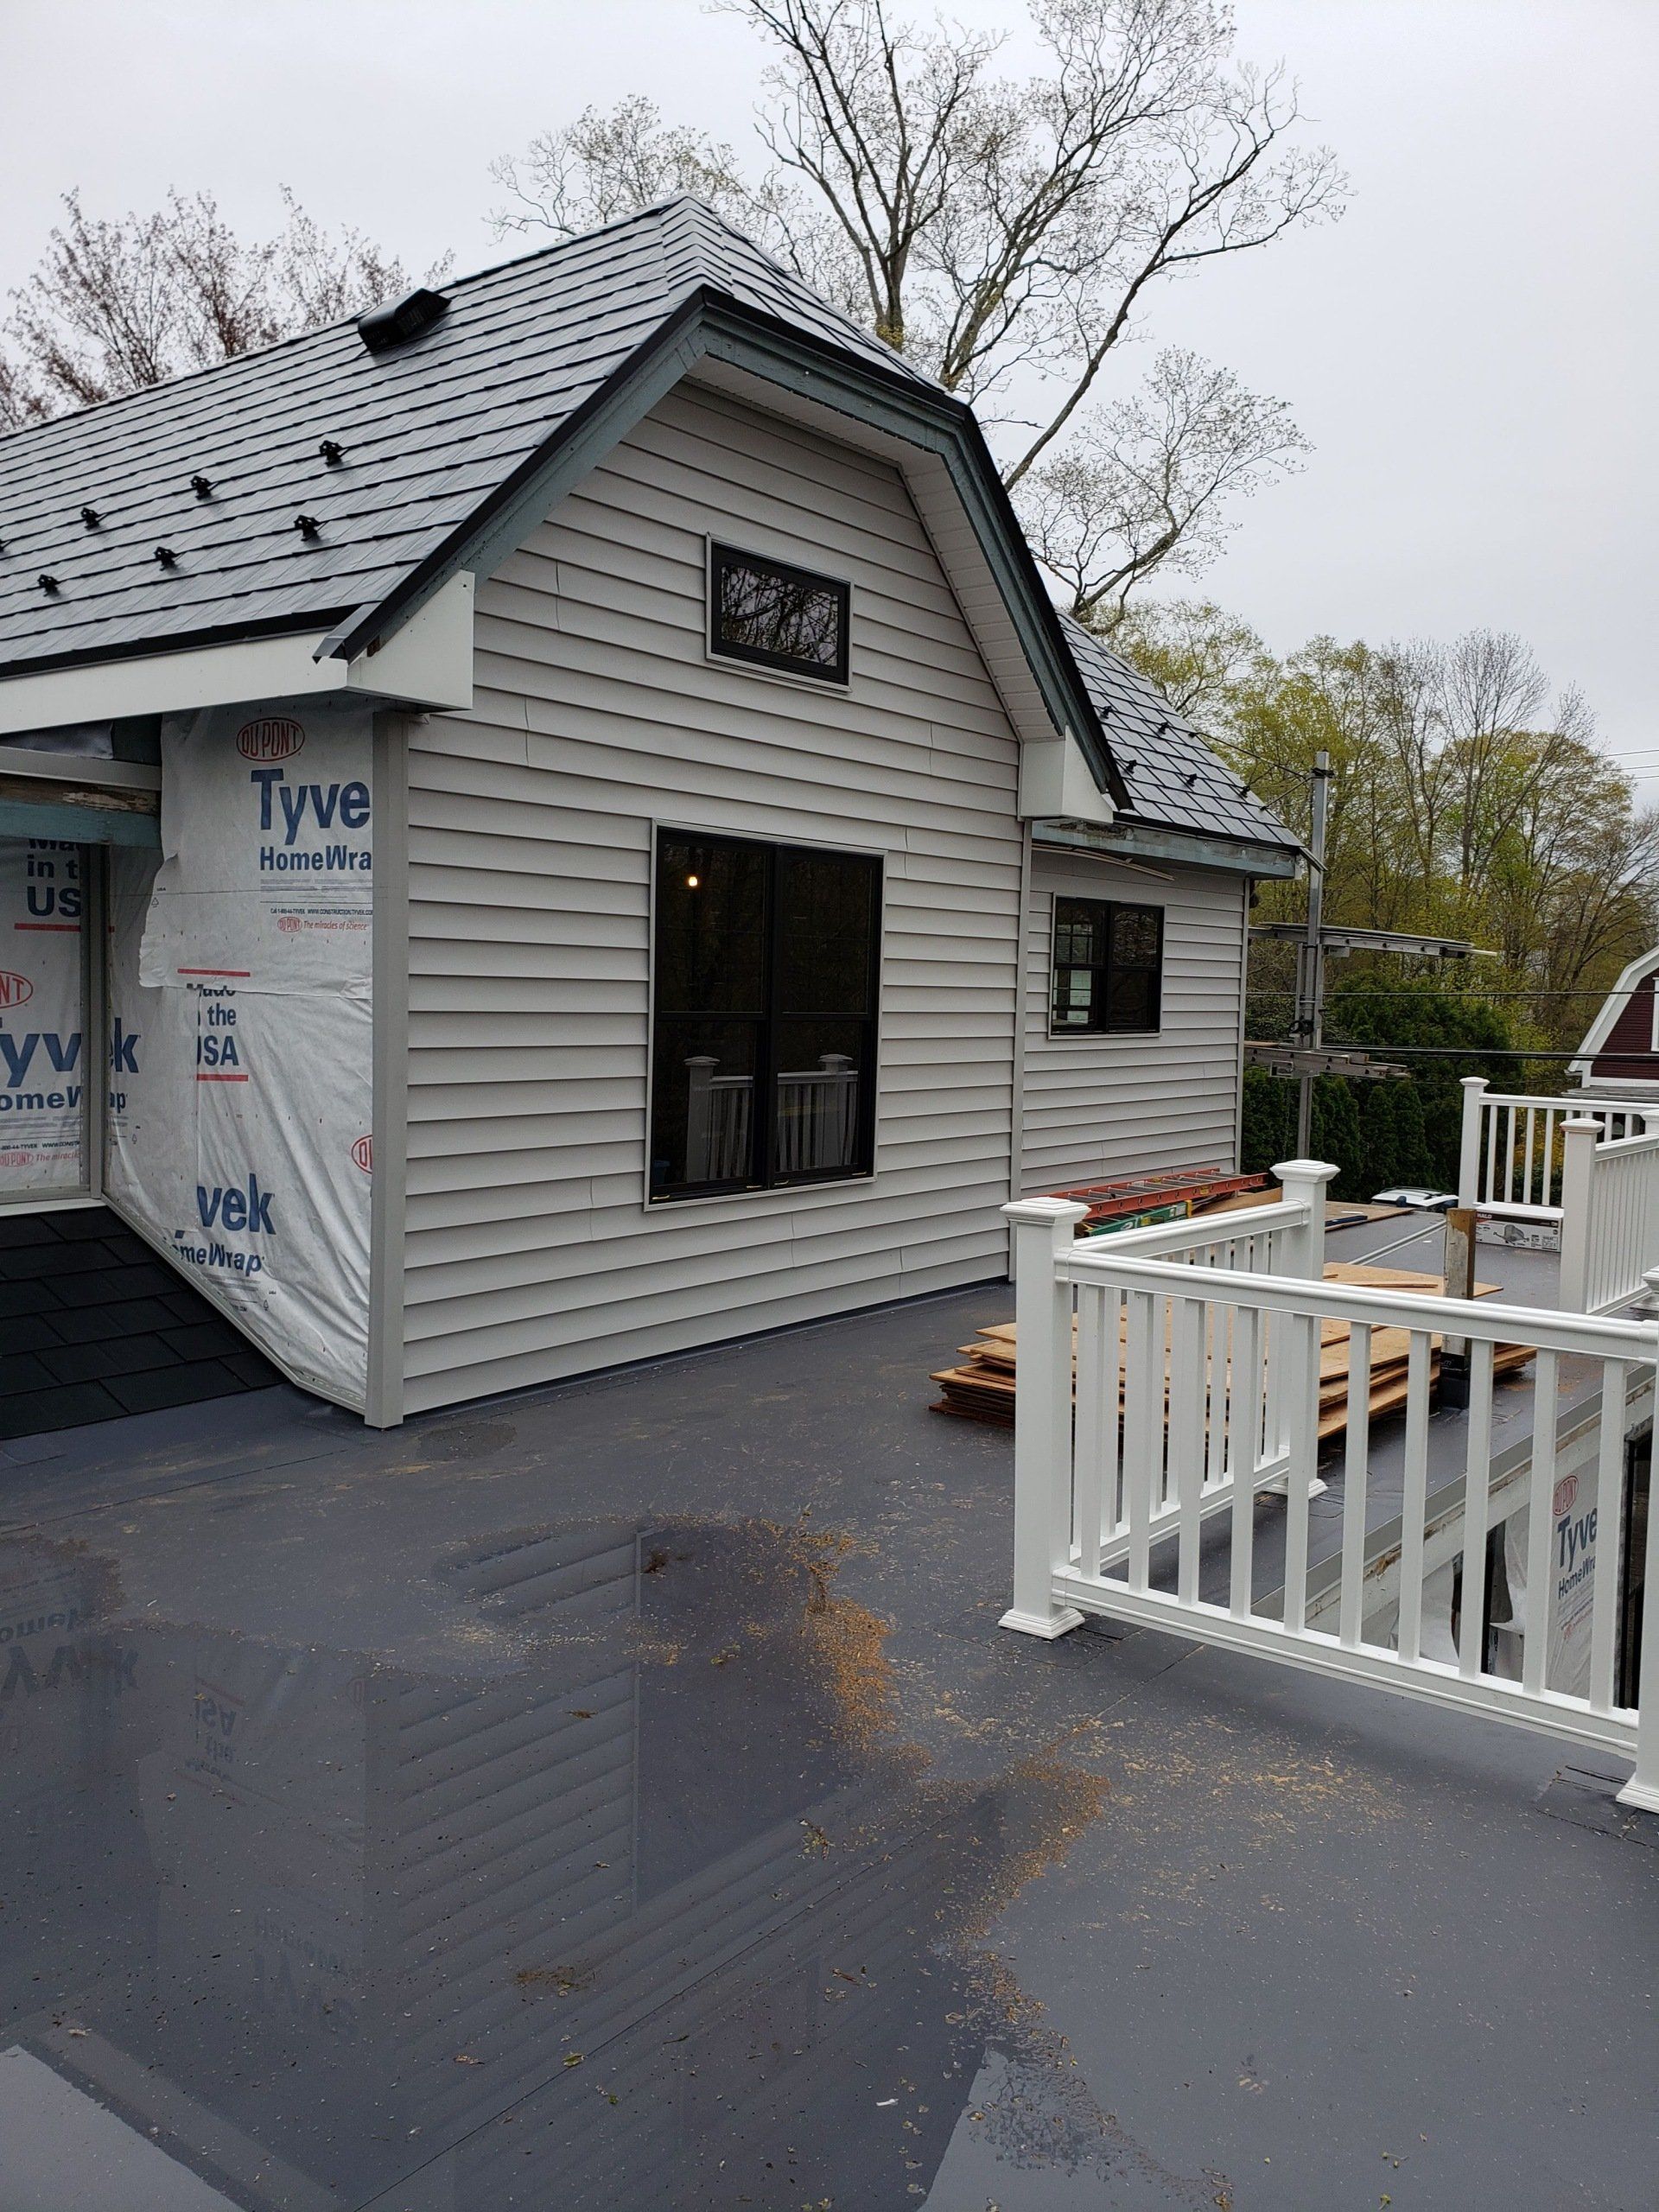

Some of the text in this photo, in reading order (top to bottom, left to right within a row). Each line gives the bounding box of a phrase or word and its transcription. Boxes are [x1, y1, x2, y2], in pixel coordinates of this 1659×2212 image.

[251, 768, 371, 846] Tyve
[260, 845, 372, 871] HomeWra
[315, 920, 338, 931] miracles
[340, 921, 346, 931] of
[207, 1002, 237, 1027] the
[197, 1035, 239, 1066] SA
